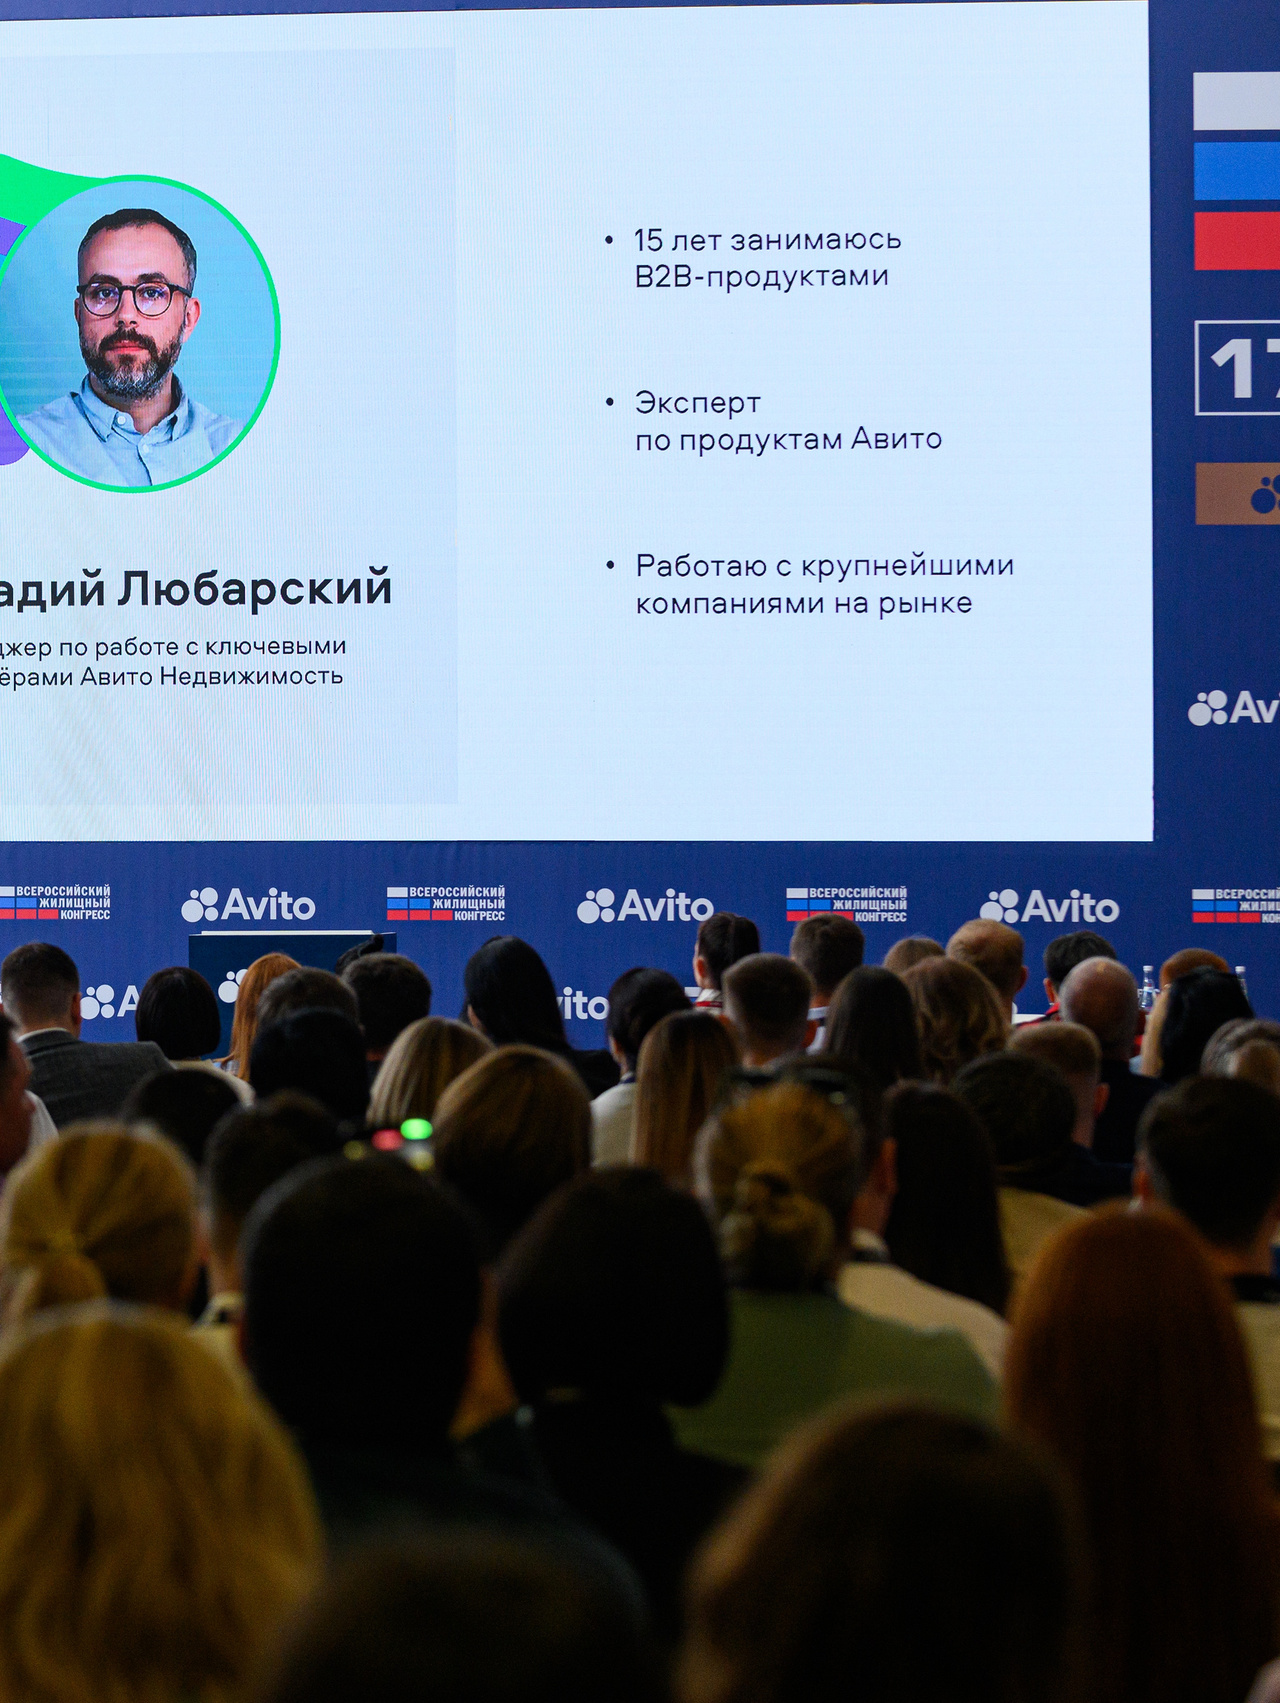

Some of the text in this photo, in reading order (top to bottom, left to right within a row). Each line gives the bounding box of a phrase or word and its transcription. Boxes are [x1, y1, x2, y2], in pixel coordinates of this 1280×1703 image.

[635, 229, 901, 251] 15 лет занимаюсь
[636, 390, 761, 419] Эксперт
[637, 426, 941, 457] по продуктам Авито
[638, 552, 1012, 583] Работаю с крупнейшими
[118, 566, 390, 615] Любарский
[638, 596, 971, 620] компаниями на рынке
[60, 642, 87, 656] по
[96, 637, 178, 661] работе
[187, 641, 198, 655] с
[206, 641, 345, 655] ключевыми
[80, 667, 152, 685] Авито
[161, 666, 342, 688] Недвижимость
[1230, 691, 1279, 723] Av
[17, 884, 110, 898] ВСЕРОССИЙСКИЙ
[410, 885, 505, 899] ВСЕРОССИЙСКИЙ
[810, 886, 907, 897] ВСЕРОССИЙСКИЙ
[40, 898, 110, 909] ЖИЛИЩНЫЙ
[61, 910, 110, 919] КОНГРЕСС
[221, 888, 315, 920] Avito
[433, 899, 505, 910] ЖИЛИЩНЫЙ
[617, 889, 714, 921] Avito
[833, 898, 907, 911] ЖИЛИЩНЫЙ
[1021, 889, 1119, 922] Avito
[455, 911, 505, 920] КОНГРЕСС
[855, 912, 906, 922] КОНГРЕСС
